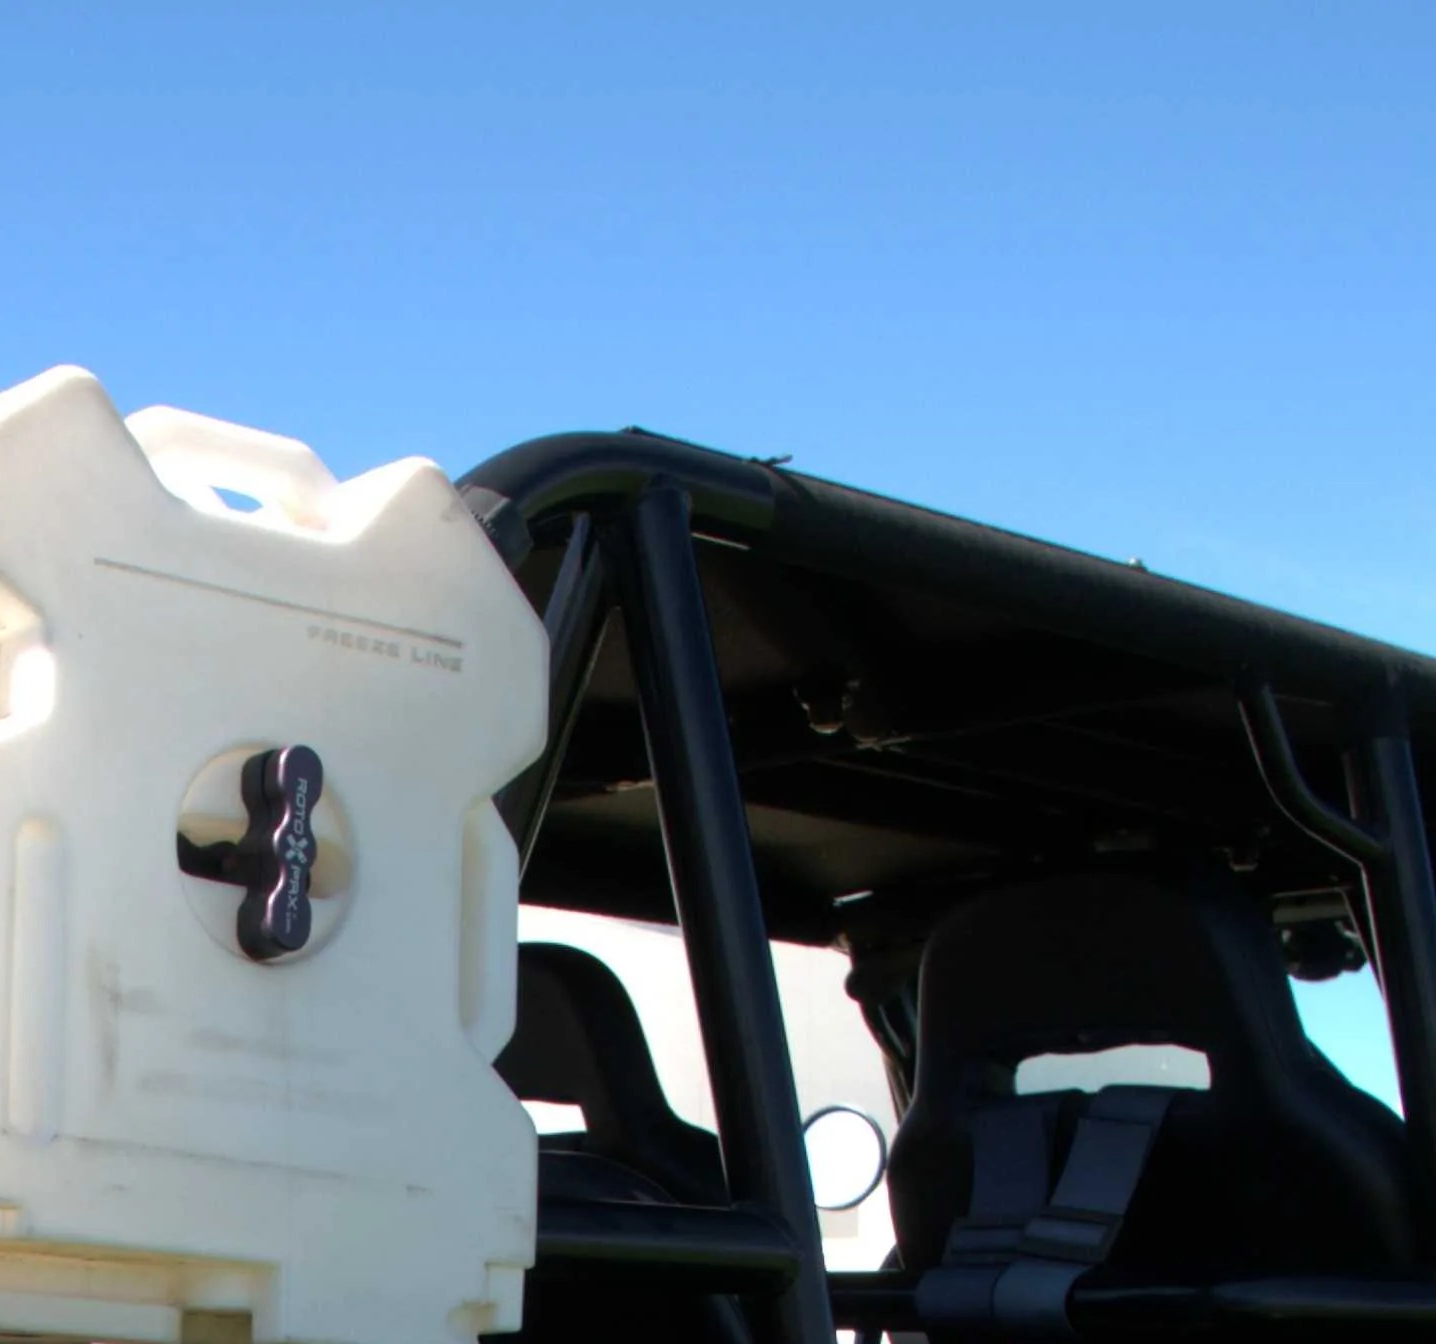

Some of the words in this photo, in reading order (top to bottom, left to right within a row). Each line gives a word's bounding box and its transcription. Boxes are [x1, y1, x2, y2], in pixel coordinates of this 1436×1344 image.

[307, 625, 400, 658] FREEZE
[410, 646, 463, 673] LINE
[294, 777, 308, 836] ROTO
[288, 864, 301, 911] PAX
